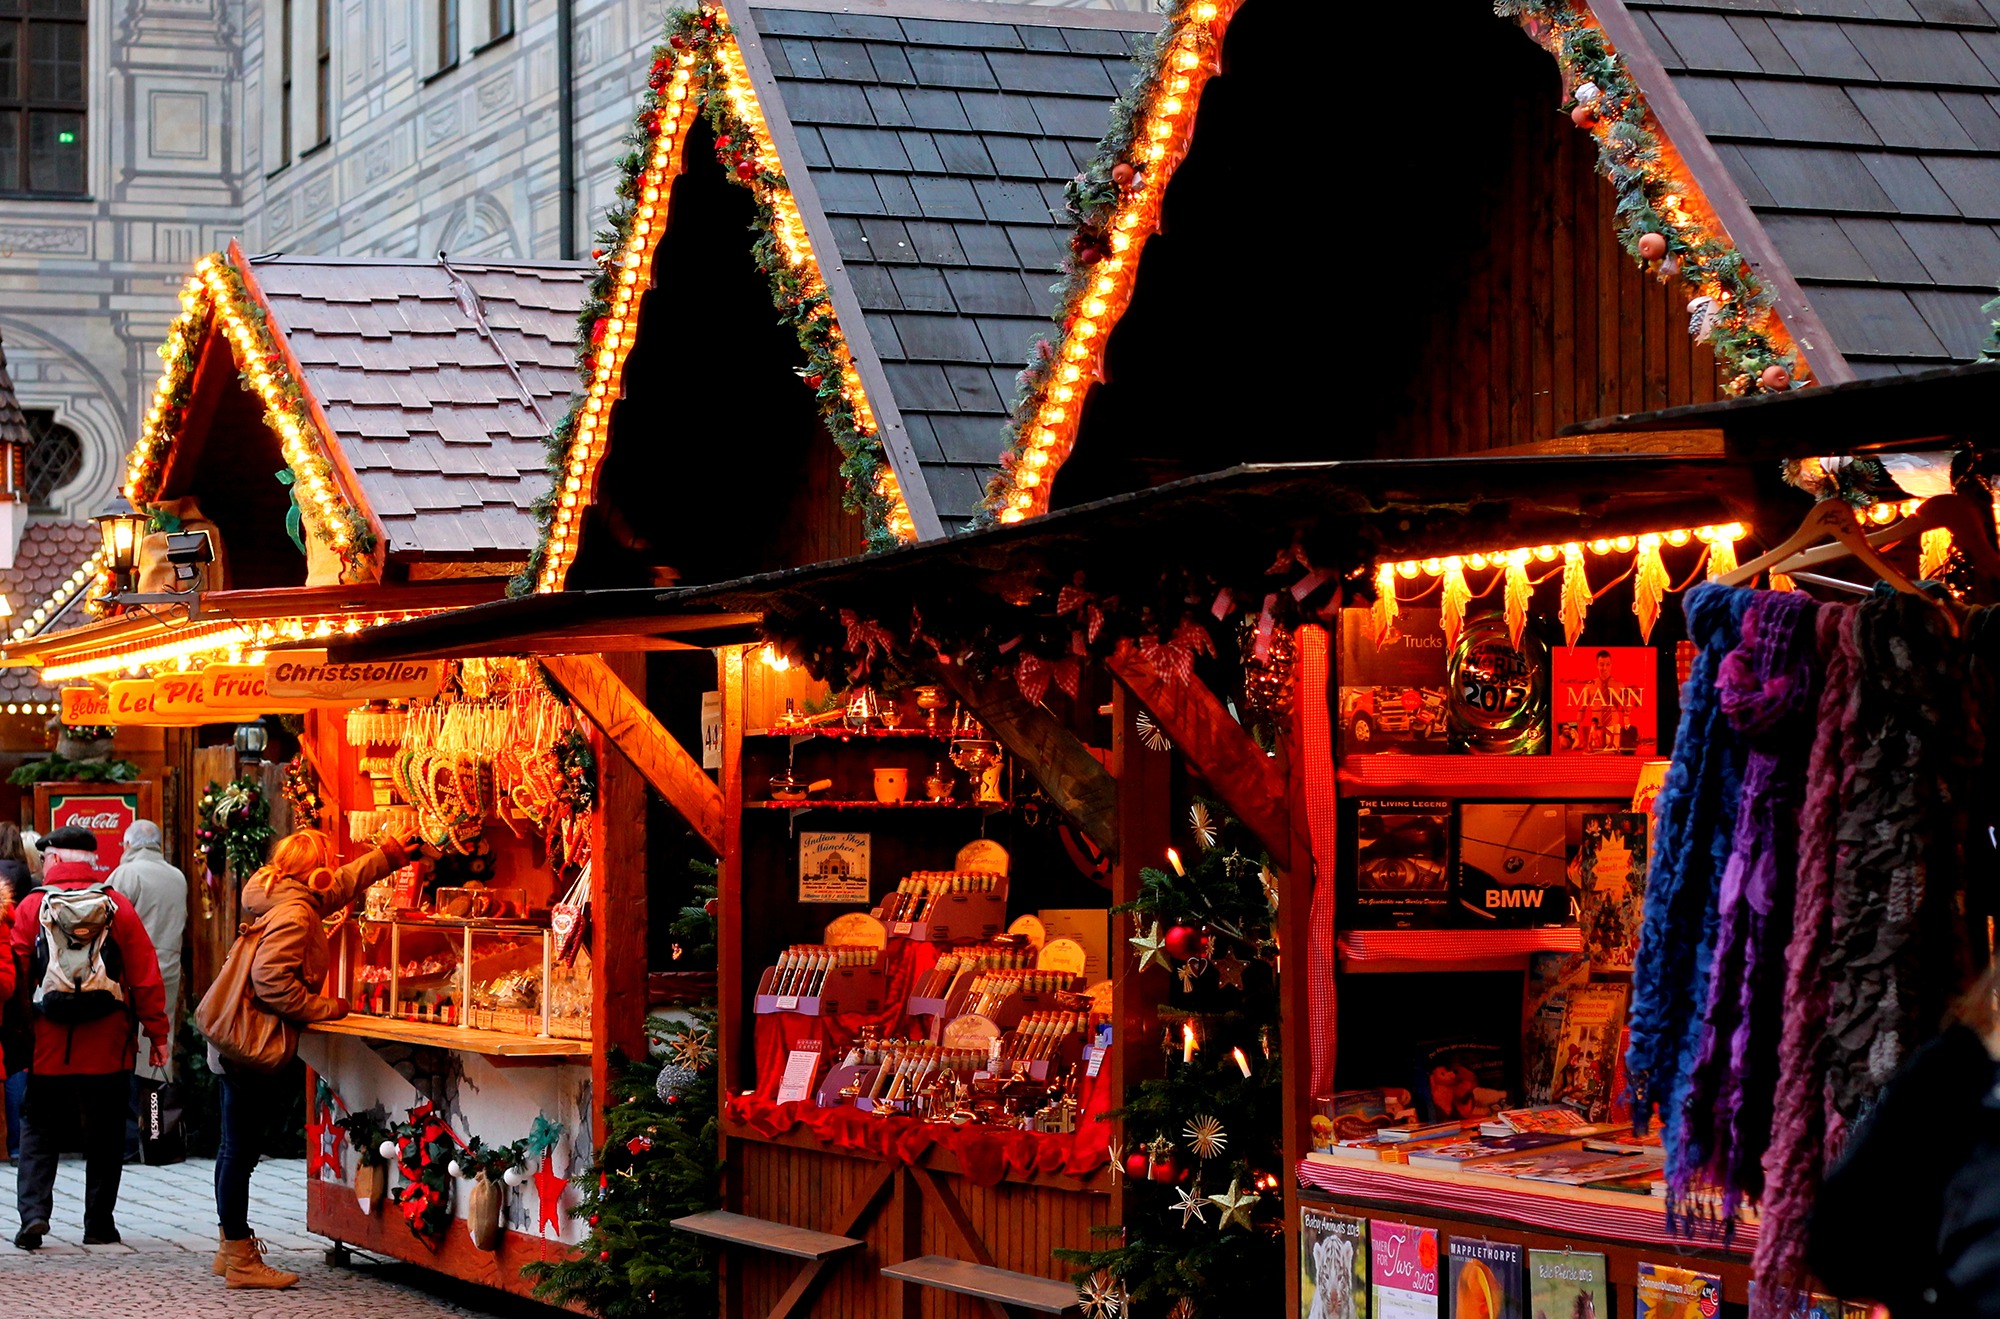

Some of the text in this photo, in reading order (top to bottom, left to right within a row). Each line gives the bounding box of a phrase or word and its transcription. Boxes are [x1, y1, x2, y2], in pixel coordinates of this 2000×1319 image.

[1402, 634, 1442, 648] Trucks
[275, 662, 428, 682] Christstollen
[1466, 656, 1529, 676] WORLD
[213, 673, 269, 697] Früc
[1462, 670, 1529, 688] RECORDS
[1462, 681, 1527, 712] 2013
[1567, 687, 1645, 707] MANN
[705, 724, 718, 751] 44
[1380, 800, 1410, 808] LIVING
[1412, 800, 1448, 808] LEGEND
[804, 832, 867, 848] Indian Shop
[812, 842, 856, 854] München
[1485, 889, 1544, 908] BMW
[150, 1092, 160, 1140] NESPRESSO
[1305, 1213, 1360, 1238] Baby Animals 2013
[1371, 1239, 1388, 1253] TIMER
[1384, 1234, 1415, 1277] Two
[1450, 1243, 1517, 1263] MAPPLETHORPE
[1377, 1253, 1388, 1266] FOR
[1412, 1270, 1435, 1292] 2013
[1554, 1264, 1578, 1281] Pferde
[1579, 1269, 1593, 1282] 2013
[1640, 1277, 1683, 1293] Sonnenblumen
[1683, 1283, 1698, 1297] 2013
